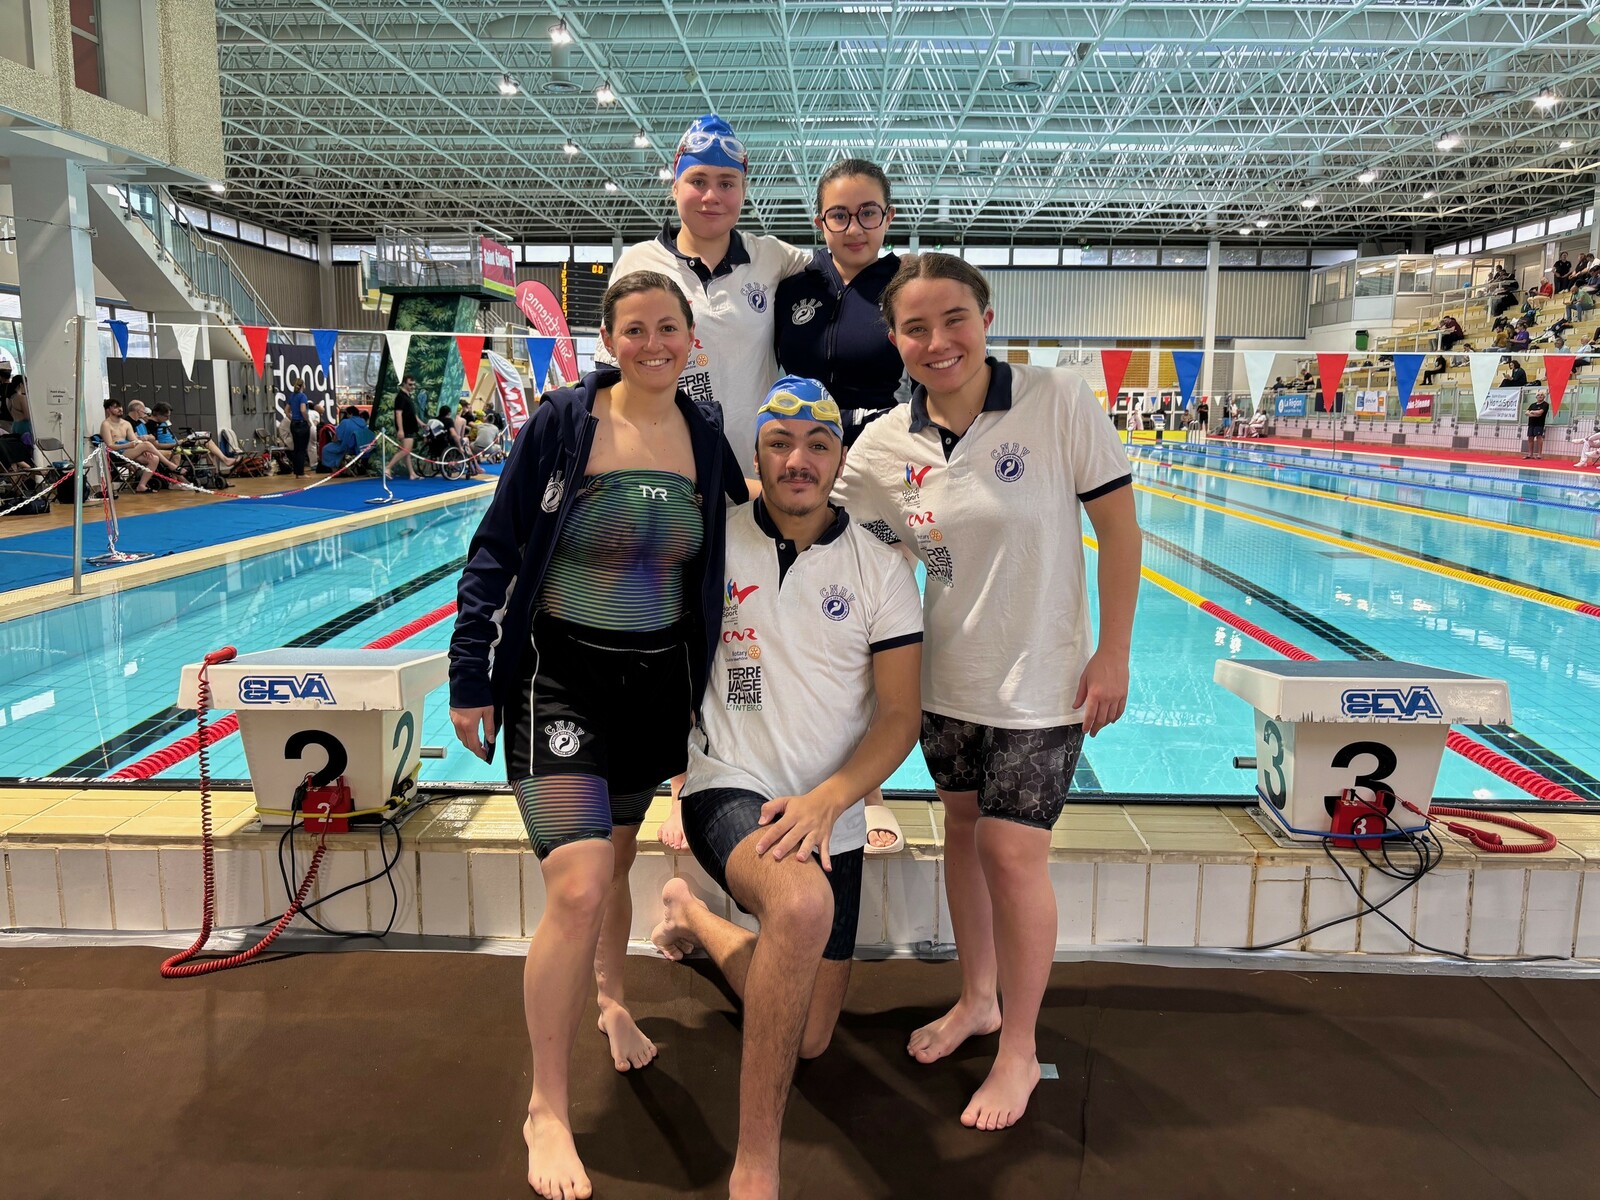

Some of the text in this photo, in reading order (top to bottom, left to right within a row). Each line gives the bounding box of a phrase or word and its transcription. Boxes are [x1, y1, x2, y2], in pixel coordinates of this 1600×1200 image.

[677, 371, 710, 388] ERRE
[991, 442, 1030, 460] CNBV
[639, 485, 667, 501] TYR
[909, 511, 935, 527] CNR
[723, 628, 757, 643] CNR
[727, 666, 761, 680] TERRE
[239, 673, 337, 704] SEVA
[1341, 686, 1443, 720] SEVA
[545, 720, 585, 736] CNBV
[284, 730, 348, 787] 2
[391, 711, 415, 799] 2
[1263, 720, 1287, 810] 3
[1324, 741, 1397, 819] 3
[317, 803, 333, 823] 2
[1353, 817, 1367, 836] 3
